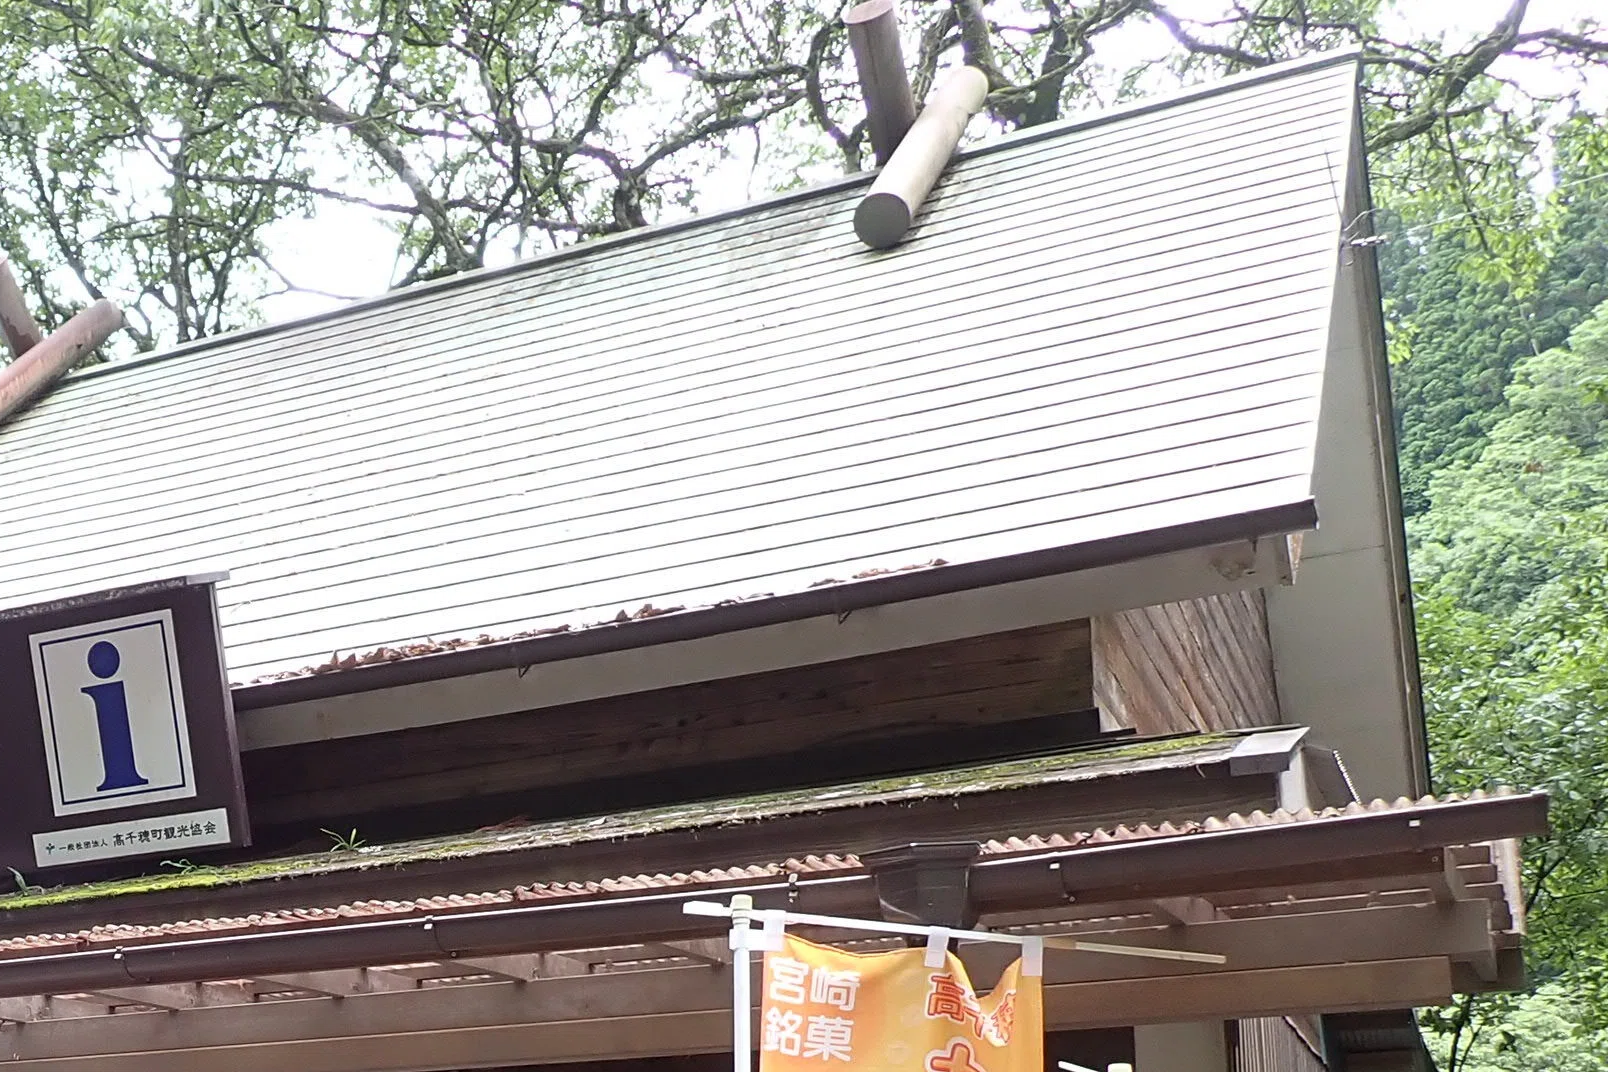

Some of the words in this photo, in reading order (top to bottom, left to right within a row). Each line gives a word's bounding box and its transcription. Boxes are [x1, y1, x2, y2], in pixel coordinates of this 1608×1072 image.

[58, 838, 108, 852] 一般社団法人
[113, 820, 217, 847] 高千穂町観光協会
[770, 956, 861, 1010] 宮崎
[763, 1006, 854, 1061] 銘菓
